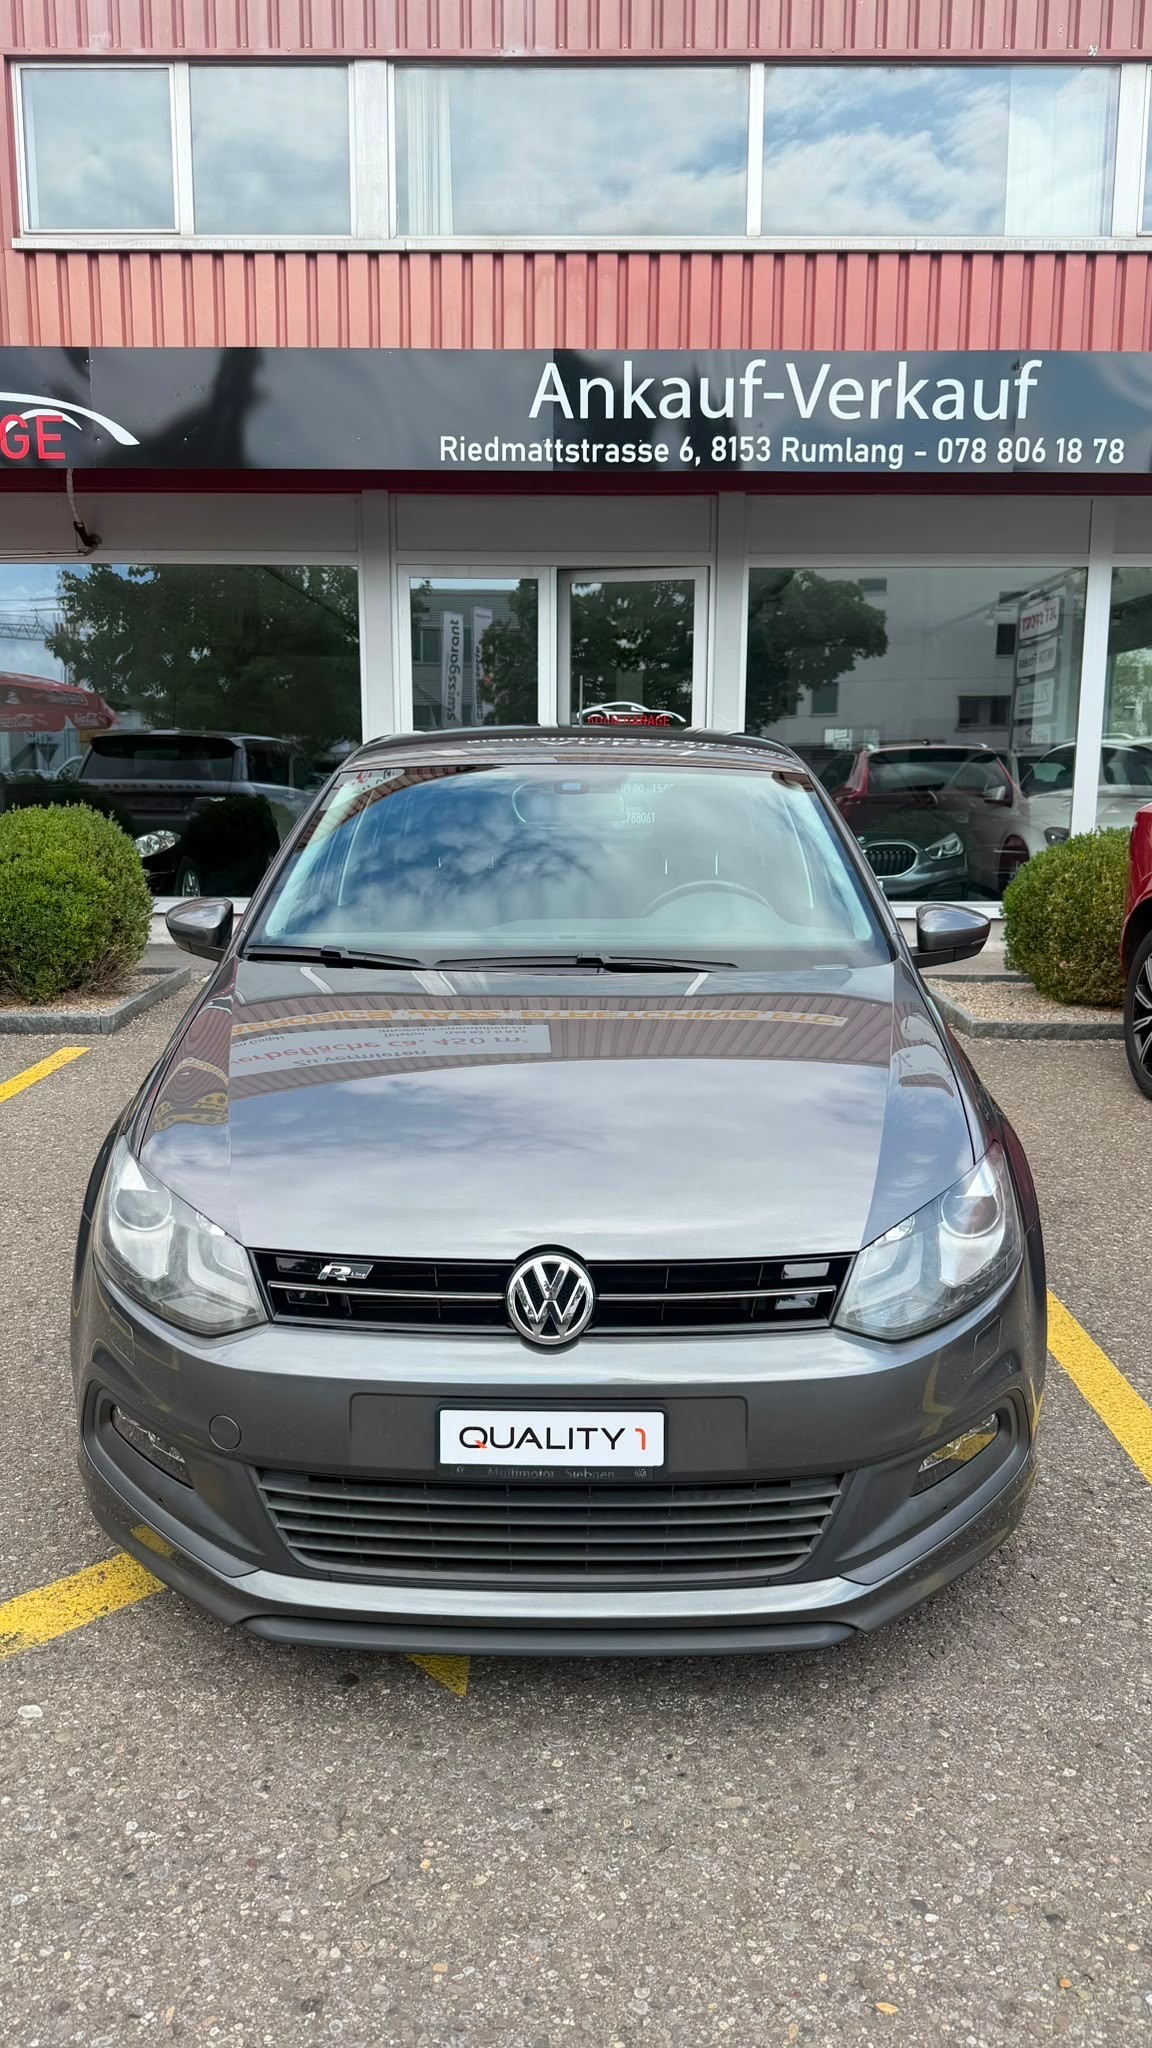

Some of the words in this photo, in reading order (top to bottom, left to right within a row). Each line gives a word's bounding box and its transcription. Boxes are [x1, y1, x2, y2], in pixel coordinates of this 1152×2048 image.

[529, 359, 1043, 421] Ankauf-Verkauf
[440, 435, 669, 463] Riedmattstrasse
[679, 437, 701, 467] 6,
[711, 436, 771, 462] 8153
[781, 436, 904, 469] Rumlang
[937, 437, 987, 464] 078
[997, 437, 1046, 464] 806
[1056, 437, 1083, 464] 18
[1093, 438, 1125, 464] 78
[458, 1426, 626, 1450] QUALITY
[634, 1427, 647, 1451] 1
